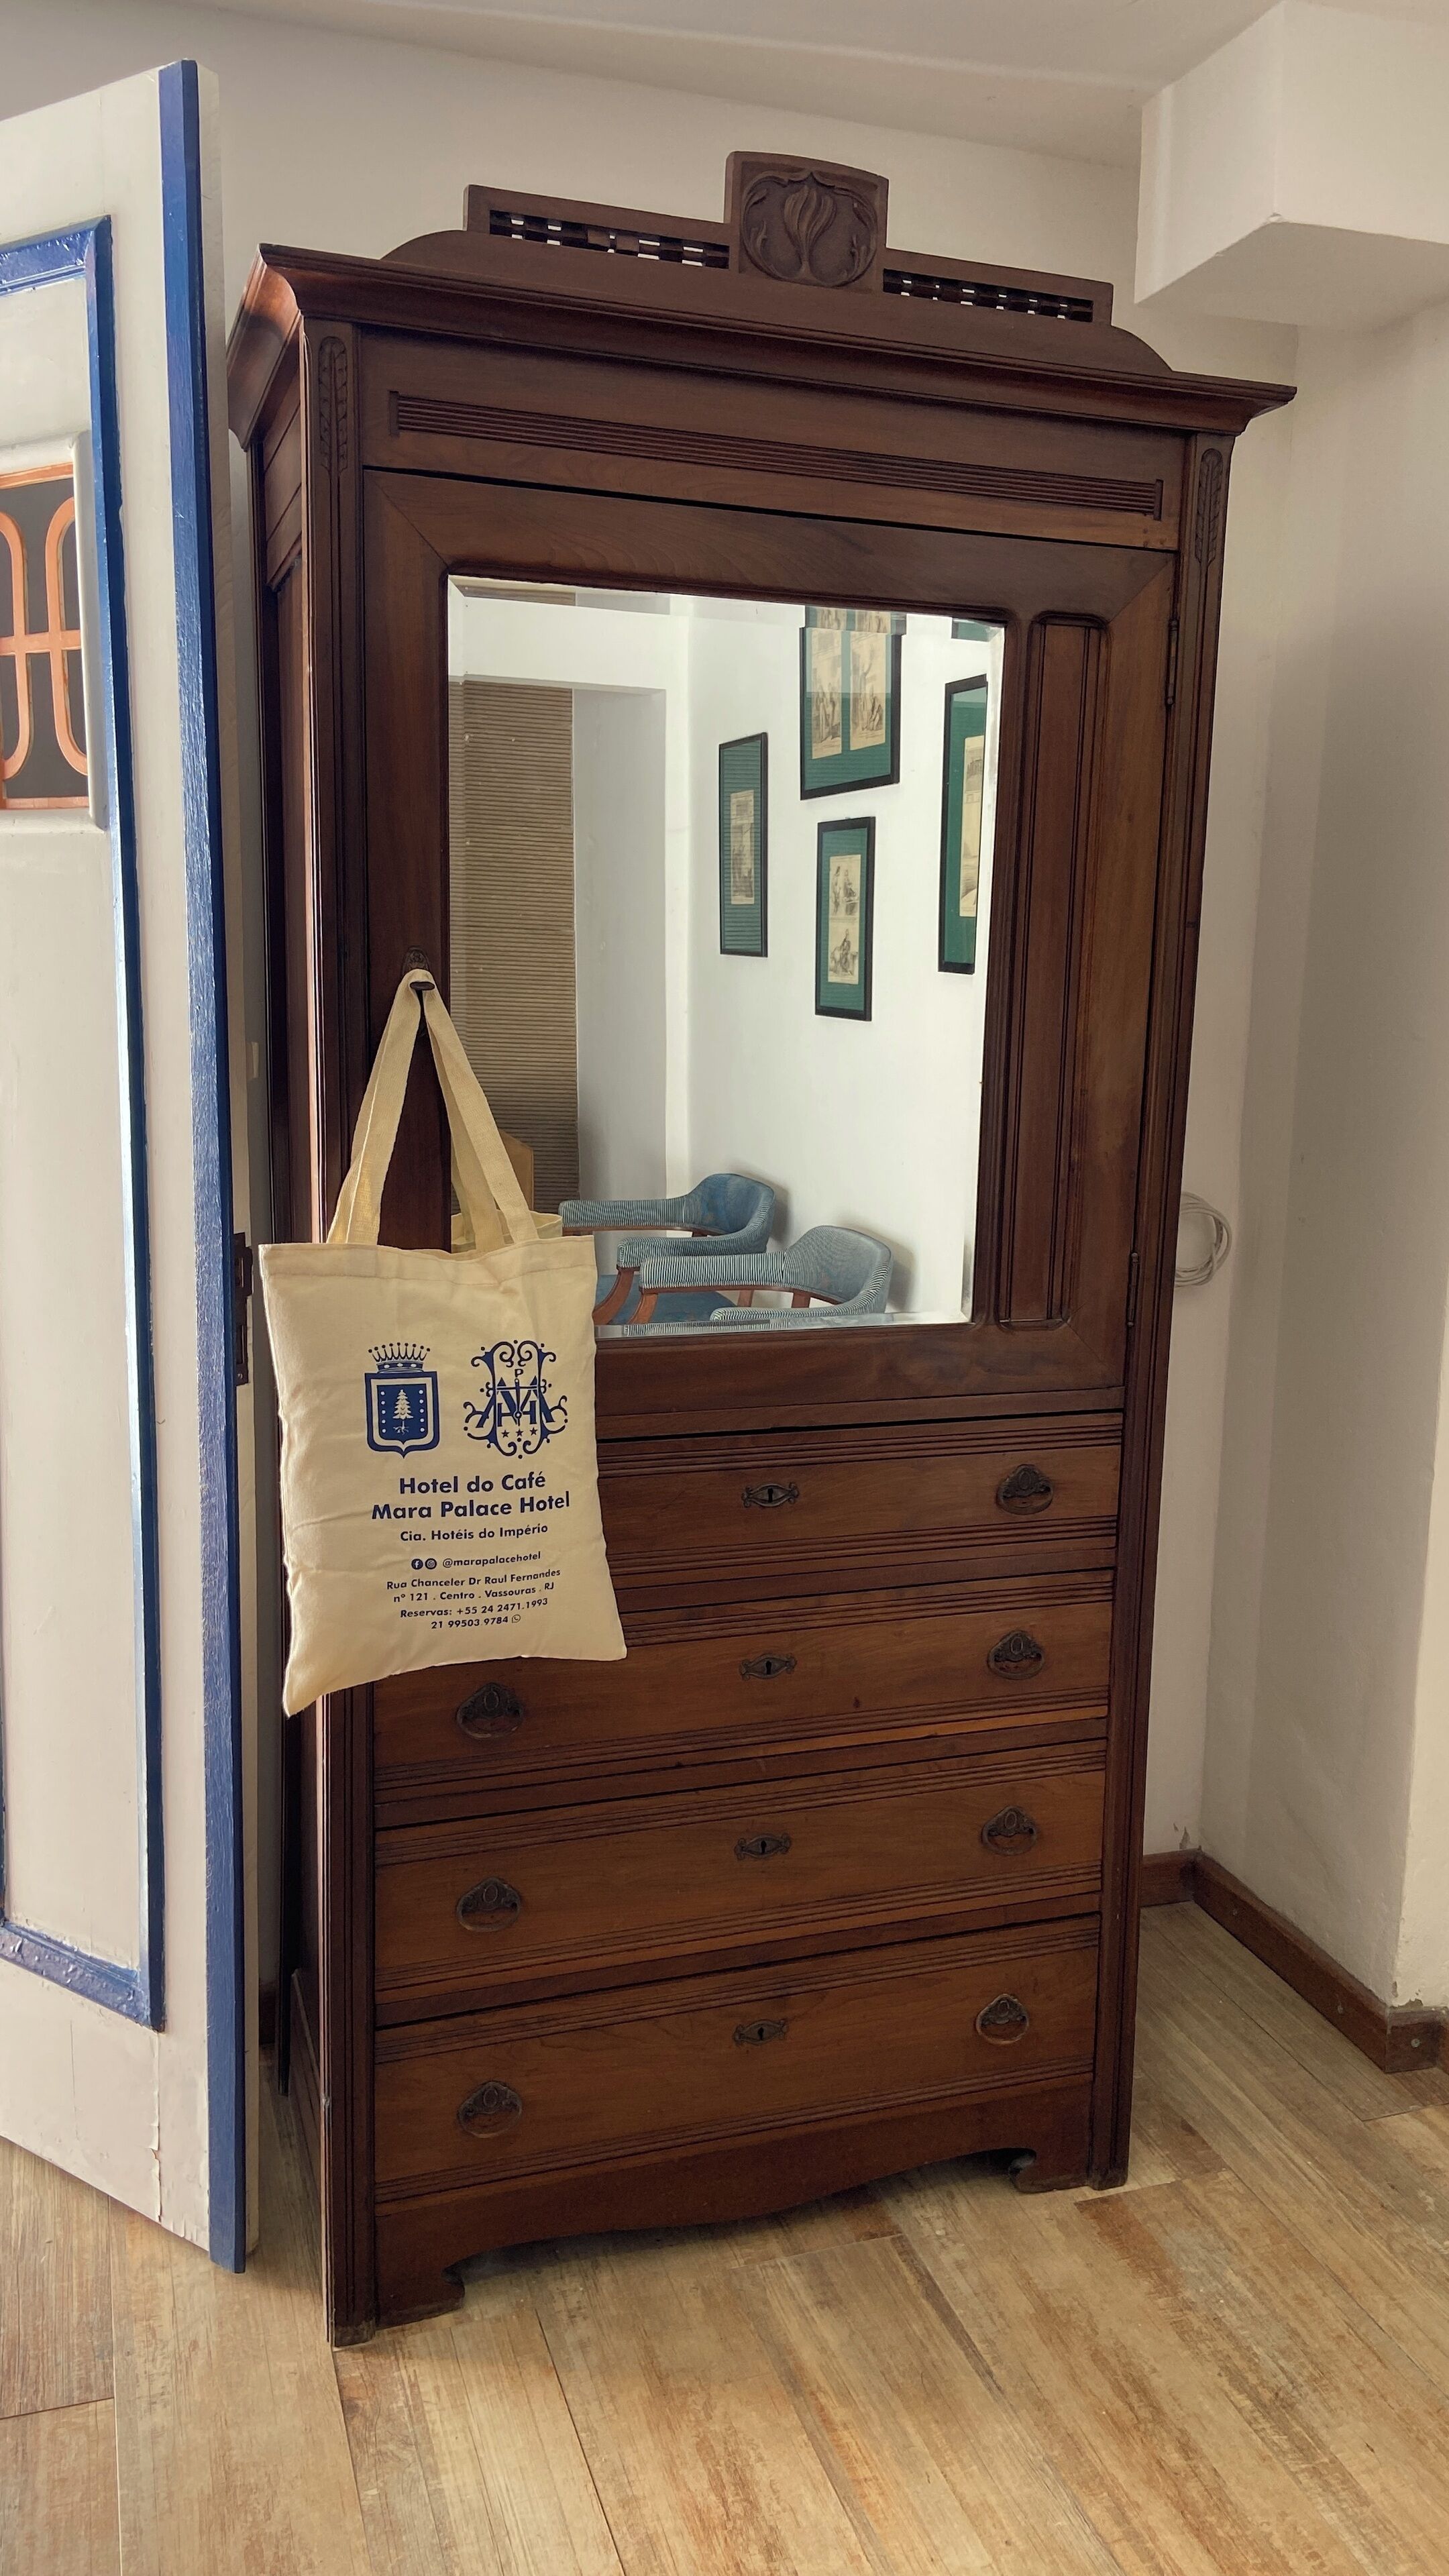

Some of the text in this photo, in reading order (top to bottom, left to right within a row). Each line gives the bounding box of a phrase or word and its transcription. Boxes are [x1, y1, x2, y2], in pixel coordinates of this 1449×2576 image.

[400, 1471, 545, 1494] Hotel do Café
[372, 1491, 570, 1519] Mara Palace Hotel
[400, 1523, 548, 1542] Cia. Hotéis do Império
[443, 1551, 541, 1568] @marapalacehotel
[386, 1569, 561, 1590] Rua Chanceler Dr Raul Fernandes
[410, 1593, 427, 1601] 121
[440, 1592, 475, 1600] Centro
[484, 1587, 536, 1598] Vassouras
[544, 1582, 554, 1590] RJ
[400, 1609, 452, 1617] Reservas:
[457, 1607, 477, 1615] +55
[481, 1605, 494, 1613] 24
